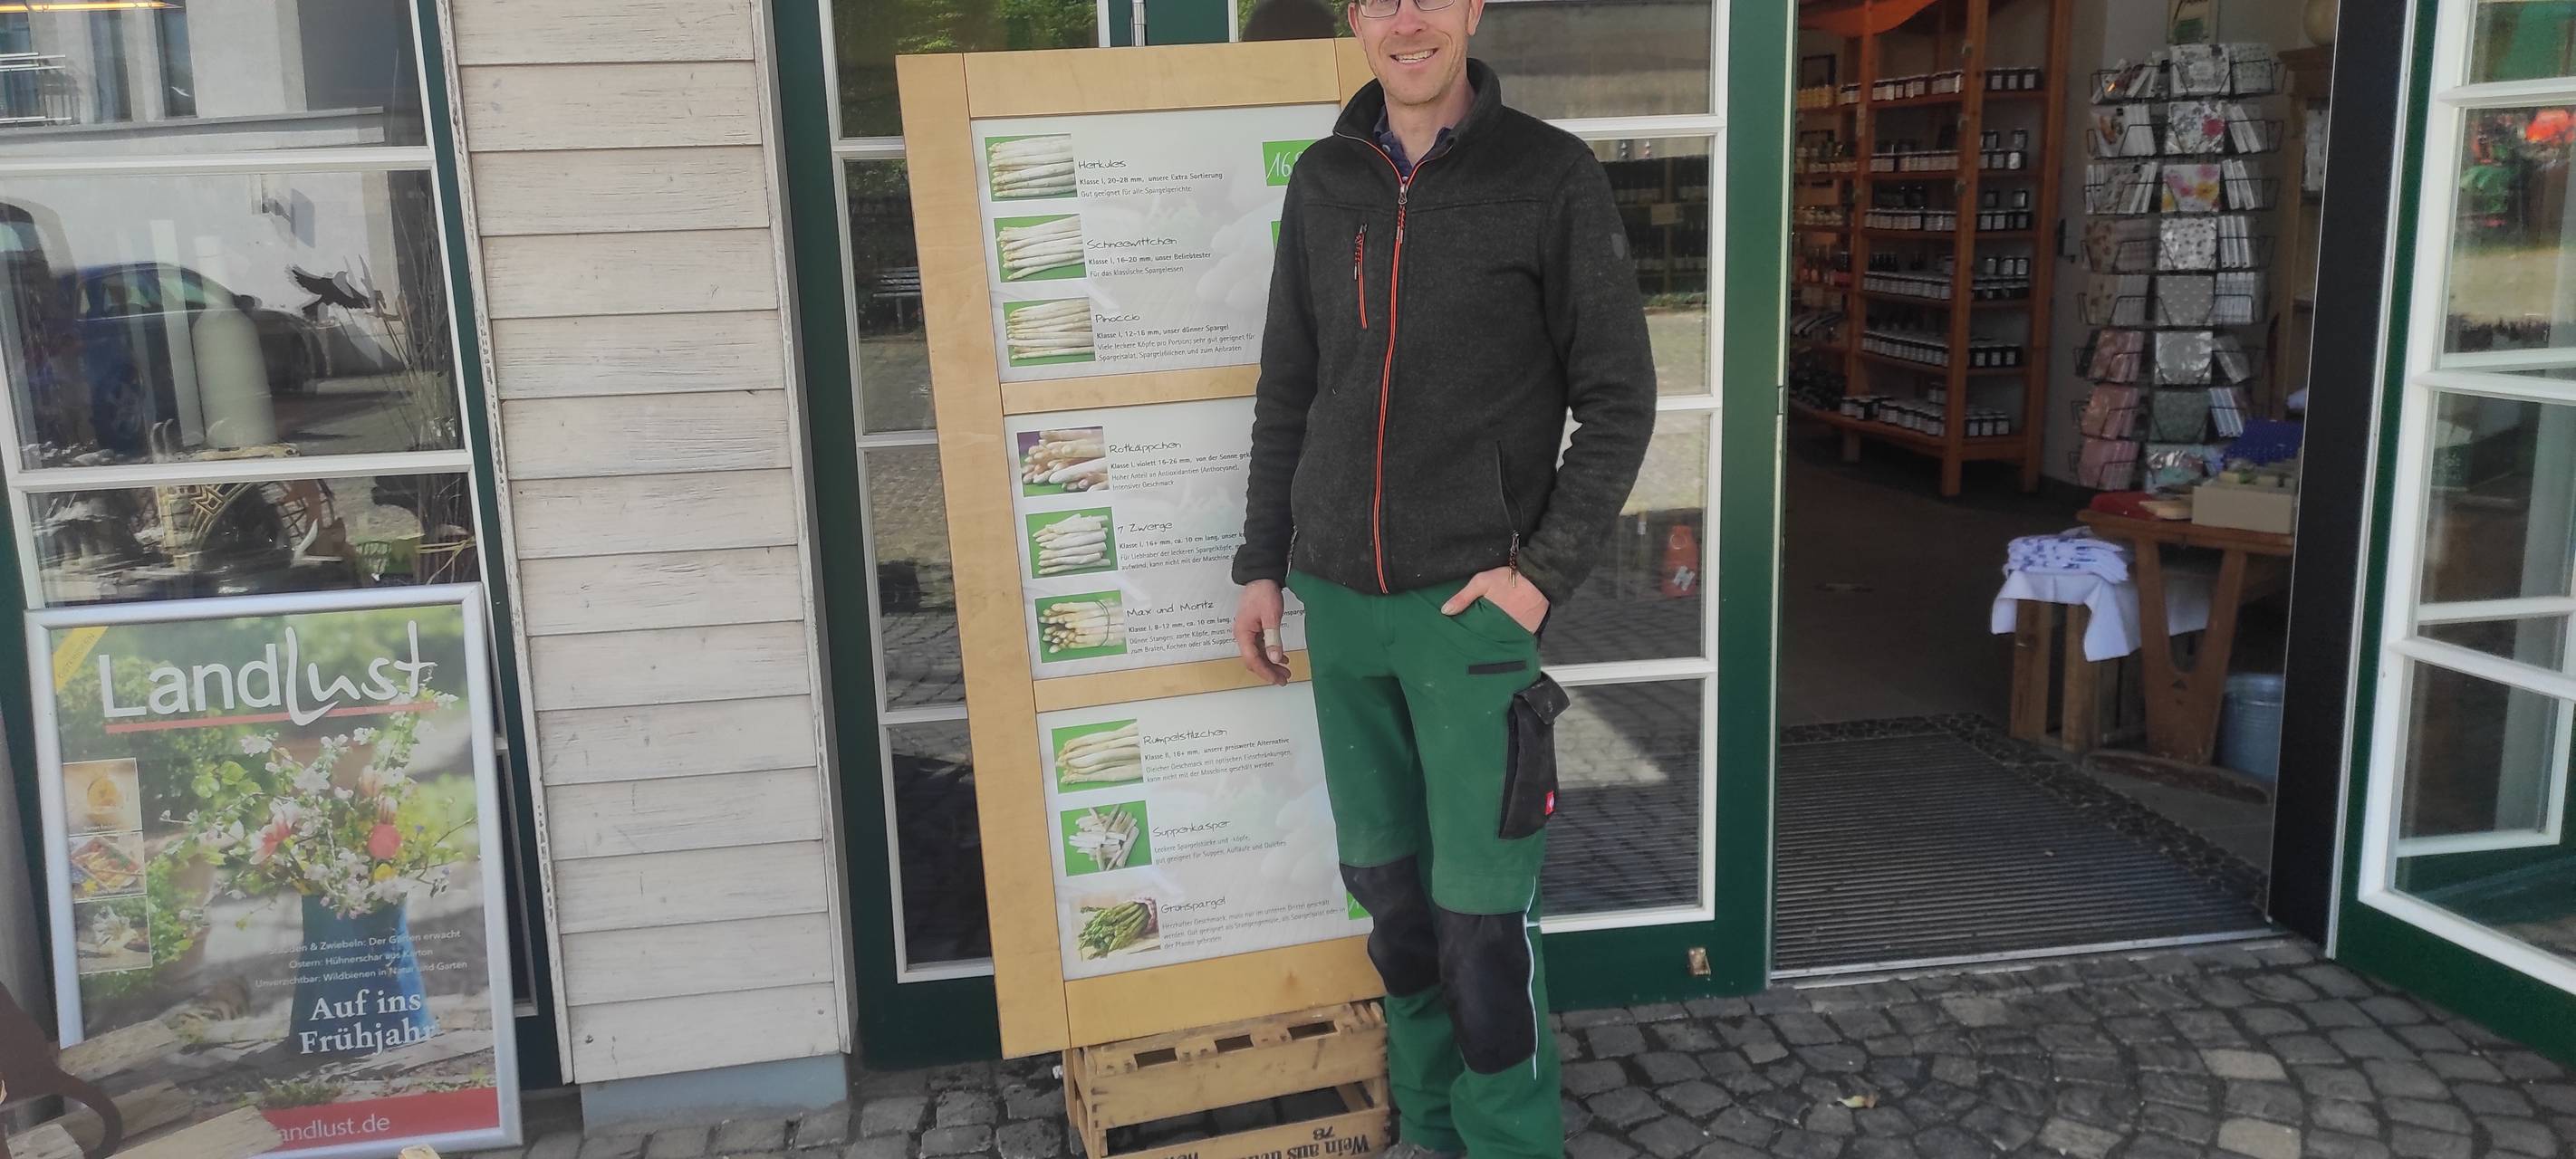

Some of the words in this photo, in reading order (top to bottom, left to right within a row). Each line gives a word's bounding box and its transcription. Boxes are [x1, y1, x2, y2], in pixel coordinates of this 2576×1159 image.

[1078, 160, 1126, 169] Herkules
[1171, 173, 1187, 181] Extra
[1189, 172, 1224, 181] Sortierung
[1094, 187, 1120, 198] geeignet
[1121, 187, 1131, 195] für
[1087, 236, 1177, 250] Schneewittchen
[1089, 257, 1110, 265] Klasse
[1115, 267, 1144, 276] klassische
[1146, 265, 1184, 275] Spargelessen
[1097, 331, 1117, 340] Klasse
[1163, 327, 1180, 335] unser
[1182, 324, 1205, 333] dünner
[1206, 323, 1229, 333] Spargel
[1098, 341, 1113, 350] Viele
[1115, 340, 1136, 350] leckere
[1193, 336, 1206, 344] sehr
[1207, 334, 1218, 344] gut
[1220, 332, 1245, 343] geeignet
[1246, 331, 1256, 340] für
[1187, 346, 1199, 355] und
[1201, 346, 1213, 354] zum
[1110, 442, 1182, 455] Rotkäppchen
[1110, 462, 1129, 470] Klasse
[1138, 459, 1157, 468] violett
[1208, 454, 1218, 462] der
[1220, 453, 1237, 461] Sonne
[1143, 479, 1174, 489] Geschmack
[1129, 522, 1173, 533] Zwerge
[1120, 542, 1139, 551] Klasse
[1222, 532, 1237, 541] unser
[1132, 550, 1158, 560] Liebhaber
[1160, 549, 1169, 558] der
[1171, 547, 1195, 557] leckeren
[1166, 558, 1180, 567] nicht
[1182, 556, 1191, 564] mit
[1193, 555, 1202, 563] der
[1203, 553, 1231, 563] Maschine
[1126, 608, 1152, 619] Max
[1157, 605, 1175, 616] und
[1180, 600, 1215, 613] Moritz
[1129, 626, 1147, 634] Klasse
[1176, 632, 1190, 640] zarte
[1211, 628, 1226, 637] muss
[1166, 639, 1187, 649] Kochen
[1189, 637, 1202, 646] oder
[1145, 753, 1163, 761] Klasse
[1203, 746, 1223, 754] unsere
[1225, 742, 1255, 753] preiswerte
[1257, 737, 1290, 748] Alternative
[1190, 769, 1200, 779] der
[1152, 820, 1231, 838] Suppenkasper
[369, 936, 387, 946] Der
[422, 928, 461, 941] erwacht
[325, 952, 383, 967] Hühnerschar
[322, 967, 376, 983] Wildbienen
[378, 967, 387, 977] in
[437, 960, 467, 972] Garten
[309, 988, 370, 1021] Auf
[377, 989, 422, 1015] ins
[299, 1016, 439, 1055] Frühjahr
[281, 1114, 391, 1142] andlust.de
